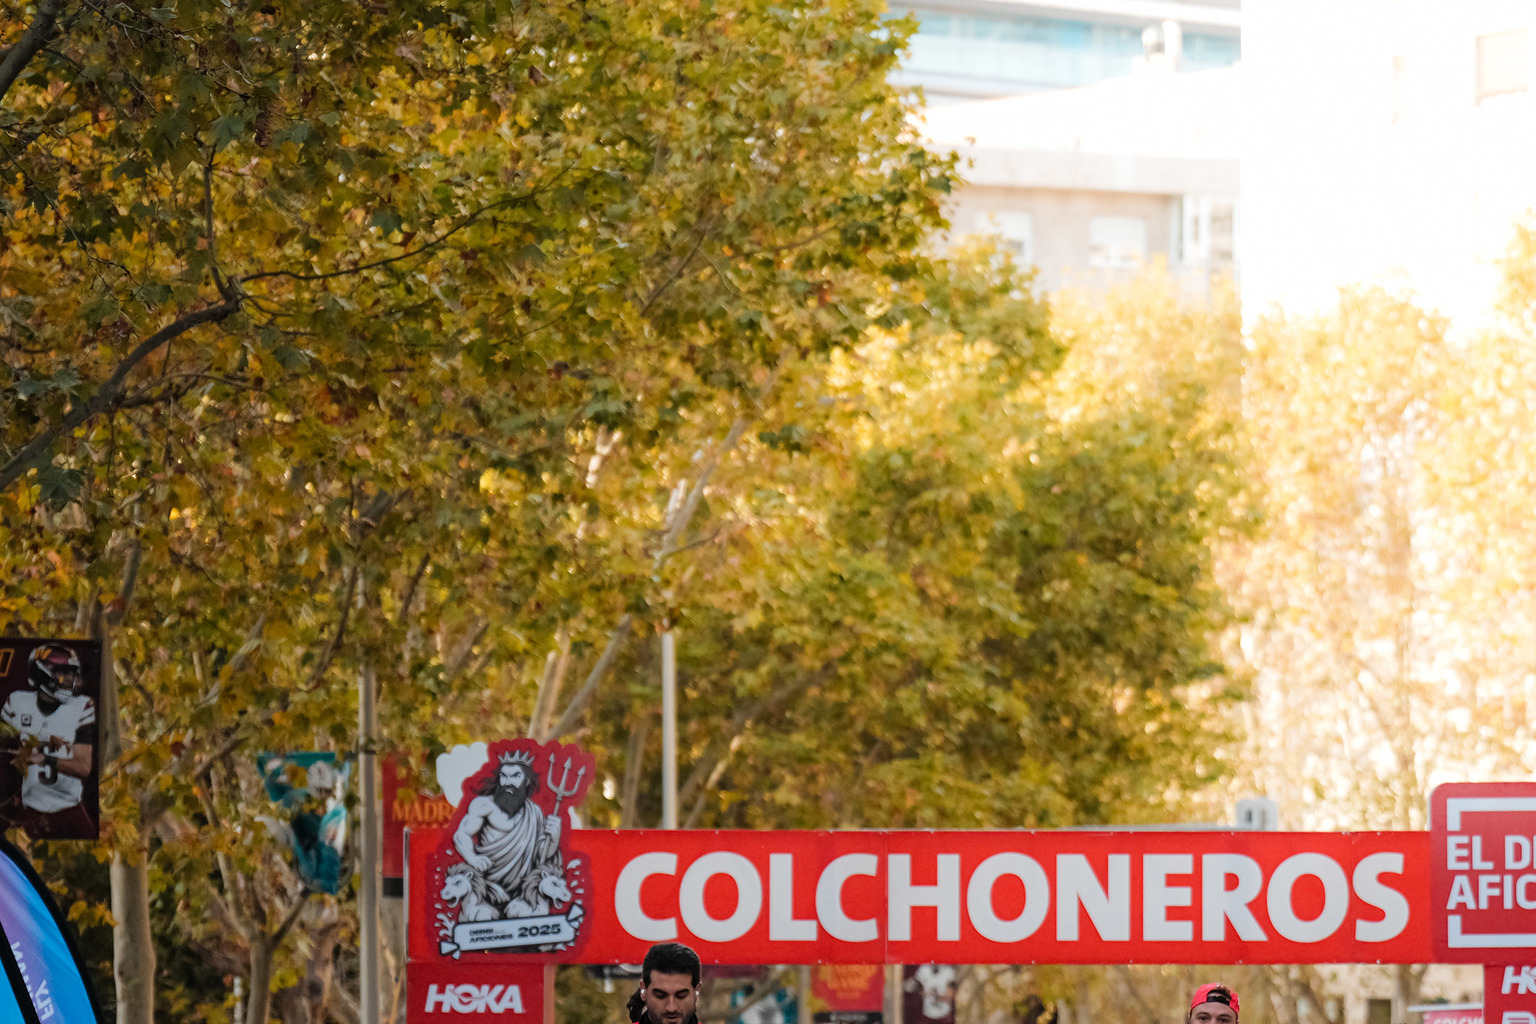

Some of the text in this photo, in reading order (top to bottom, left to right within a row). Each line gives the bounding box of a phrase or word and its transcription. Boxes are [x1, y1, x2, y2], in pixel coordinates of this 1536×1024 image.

[1447, 835, 1493, 870] EL
[614, 851, 1410, 943] COLCHONEROS
[517, 923, 561, 938] 2025
[424, 983, 524, 1014] HOKA
